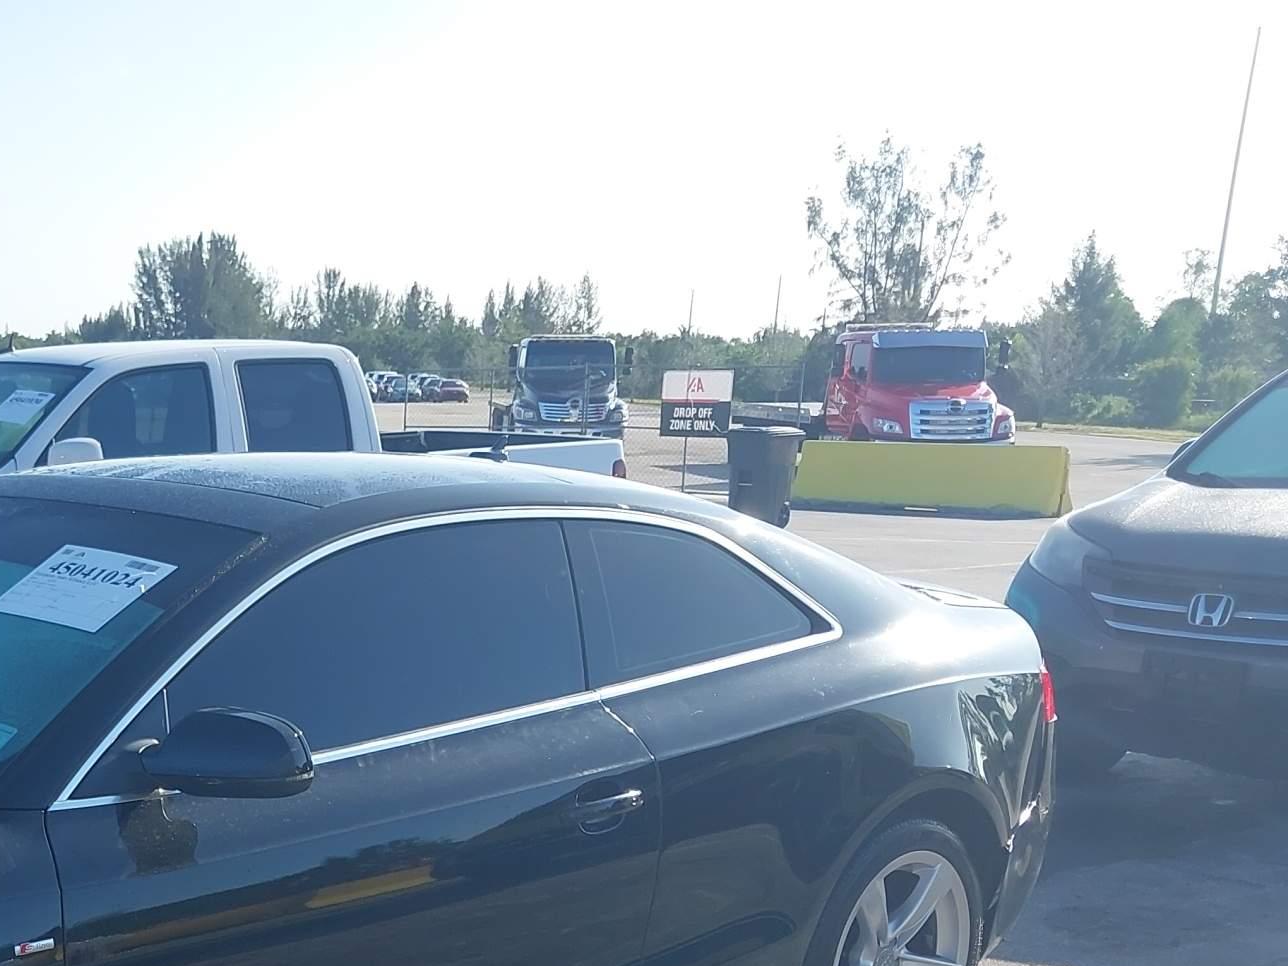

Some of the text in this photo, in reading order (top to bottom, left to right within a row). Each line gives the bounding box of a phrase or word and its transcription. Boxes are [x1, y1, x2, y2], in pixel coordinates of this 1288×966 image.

[673, 407, 713, 419] DROP OFF
[669, 419, 716, 432] ZONE ONLY
[48, 560, 144, 589] 45041024
